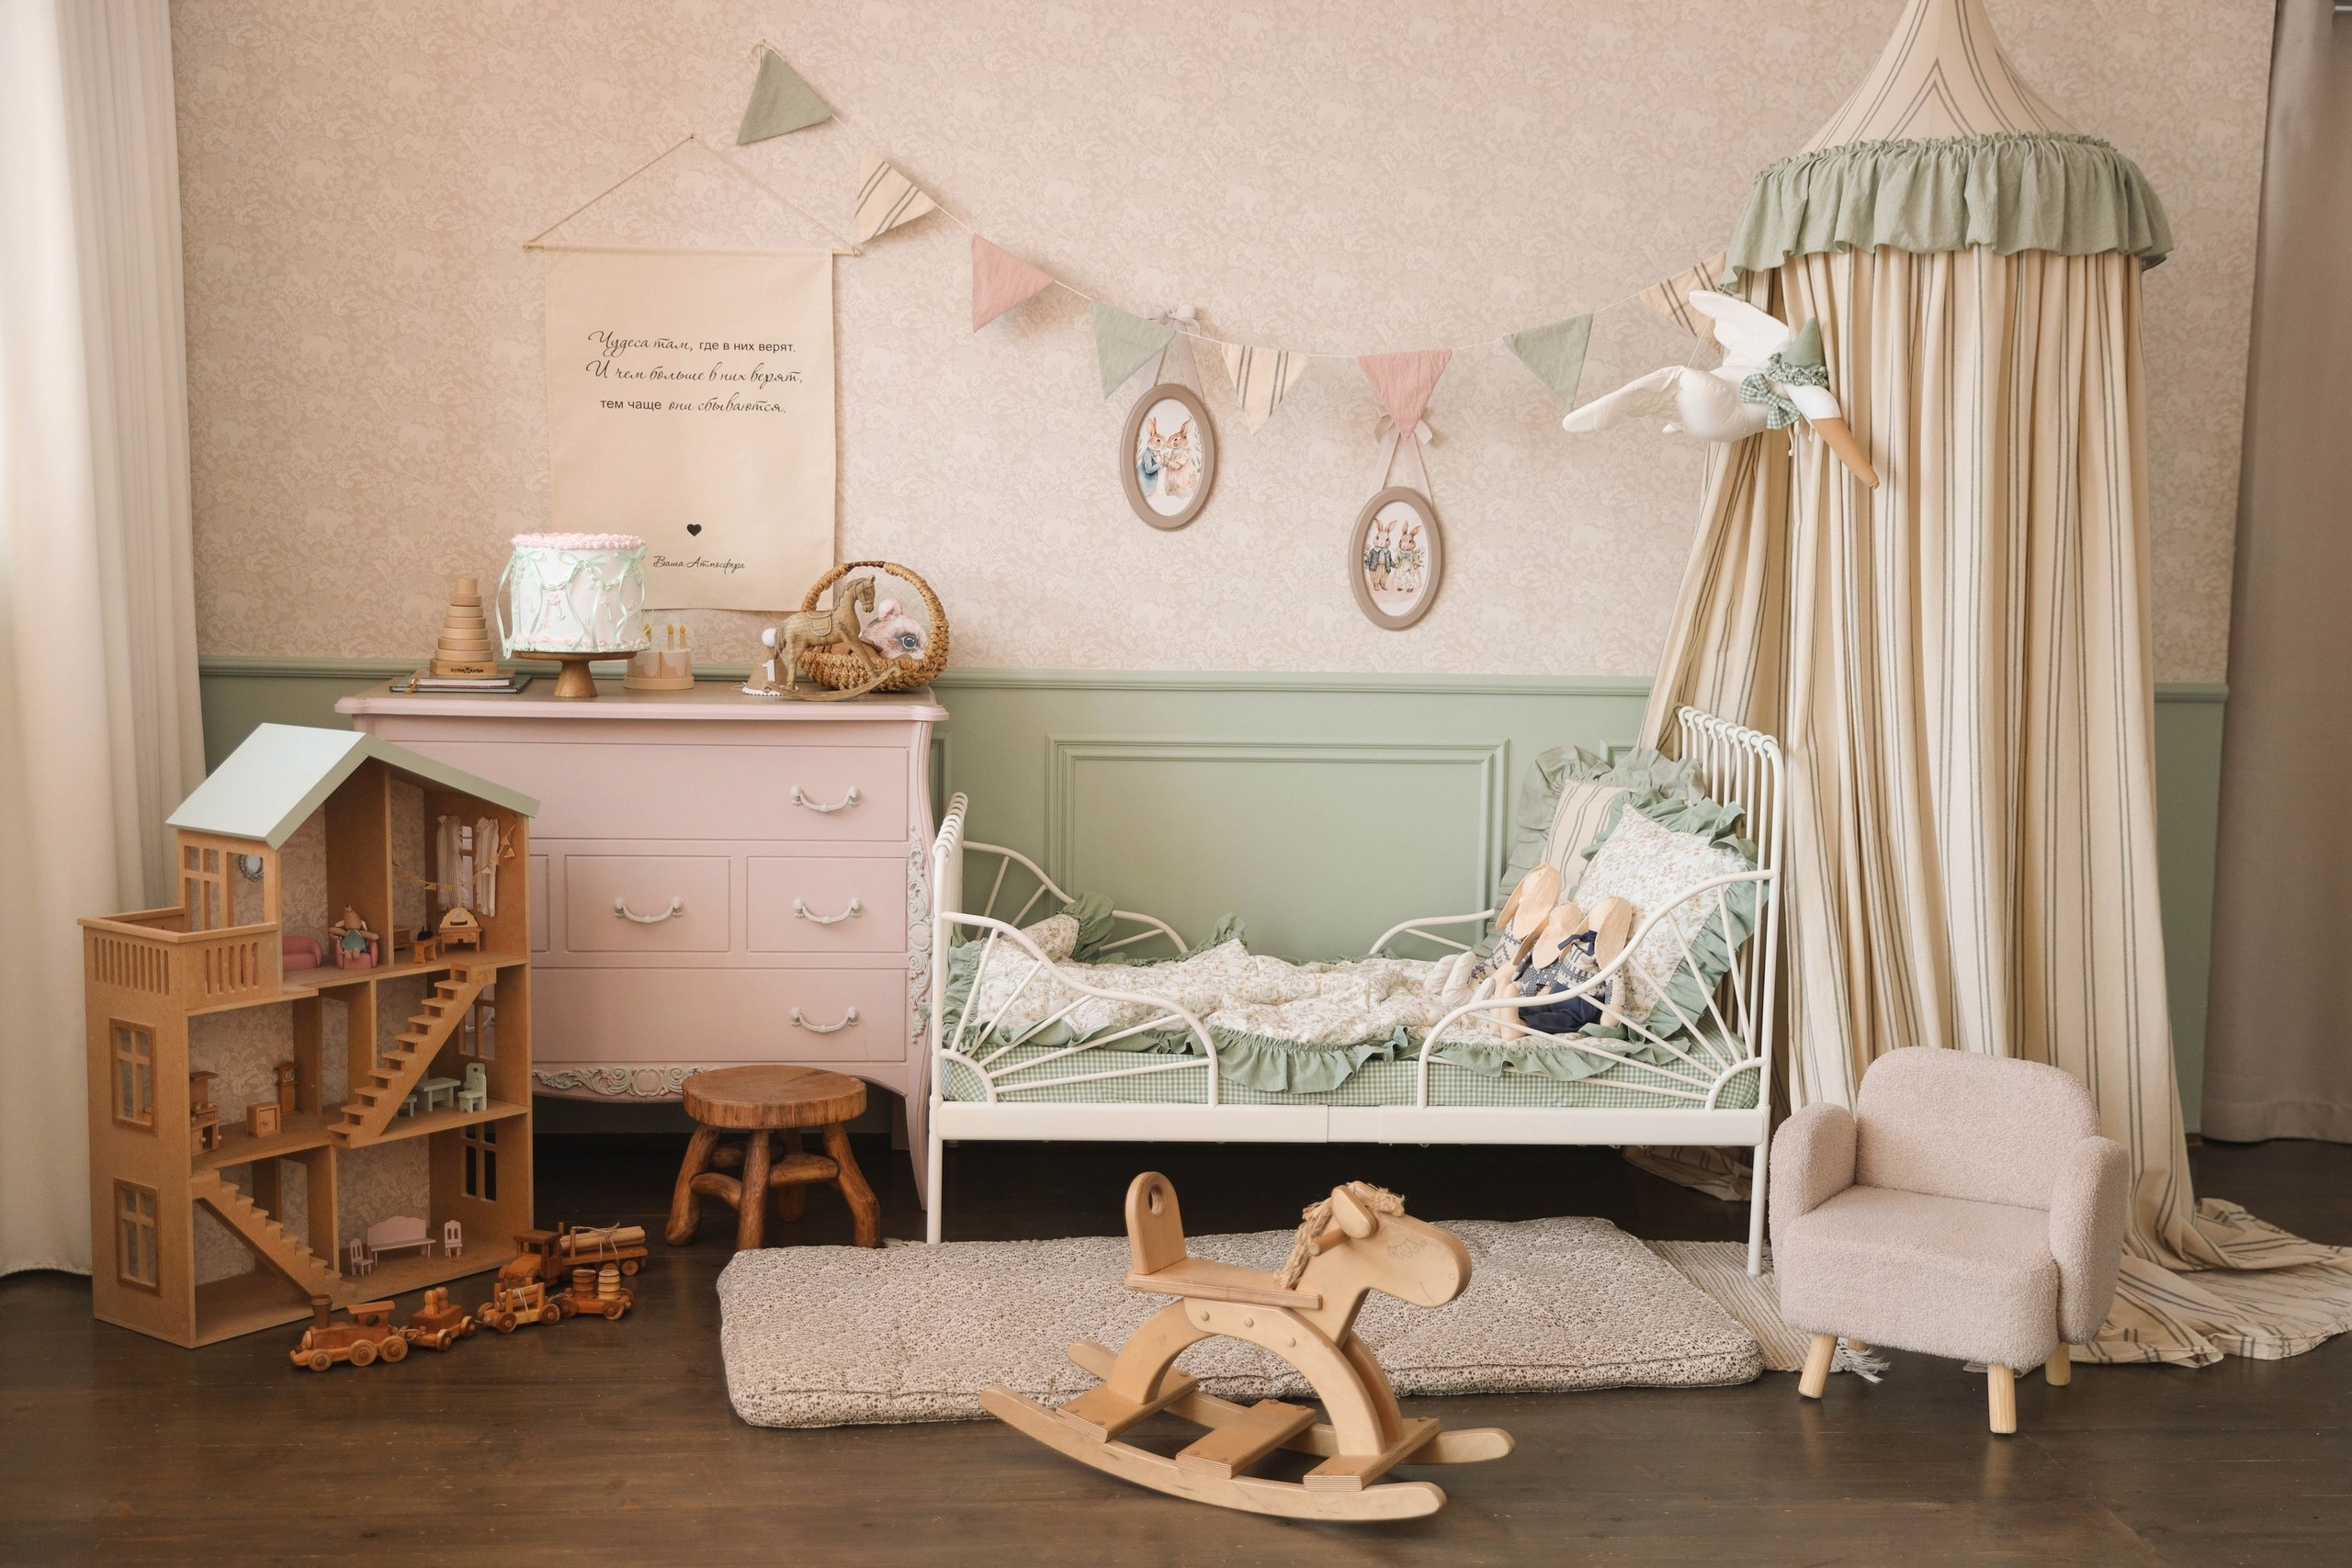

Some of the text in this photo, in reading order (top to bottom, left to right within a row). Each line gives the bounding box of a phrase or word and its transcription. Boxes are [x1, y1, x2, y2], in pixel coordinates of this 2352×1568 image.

[588, 331, 796, 357] Чудеса там, где в них верят.
[585, 360, 803, 389] И чем больше в них верят,
[600, 391, 786, 413] тем чаще они сбываются.
[653, 556, 745, 574] Ваша Атмосфера
[763, 659, 775, 682] 1
